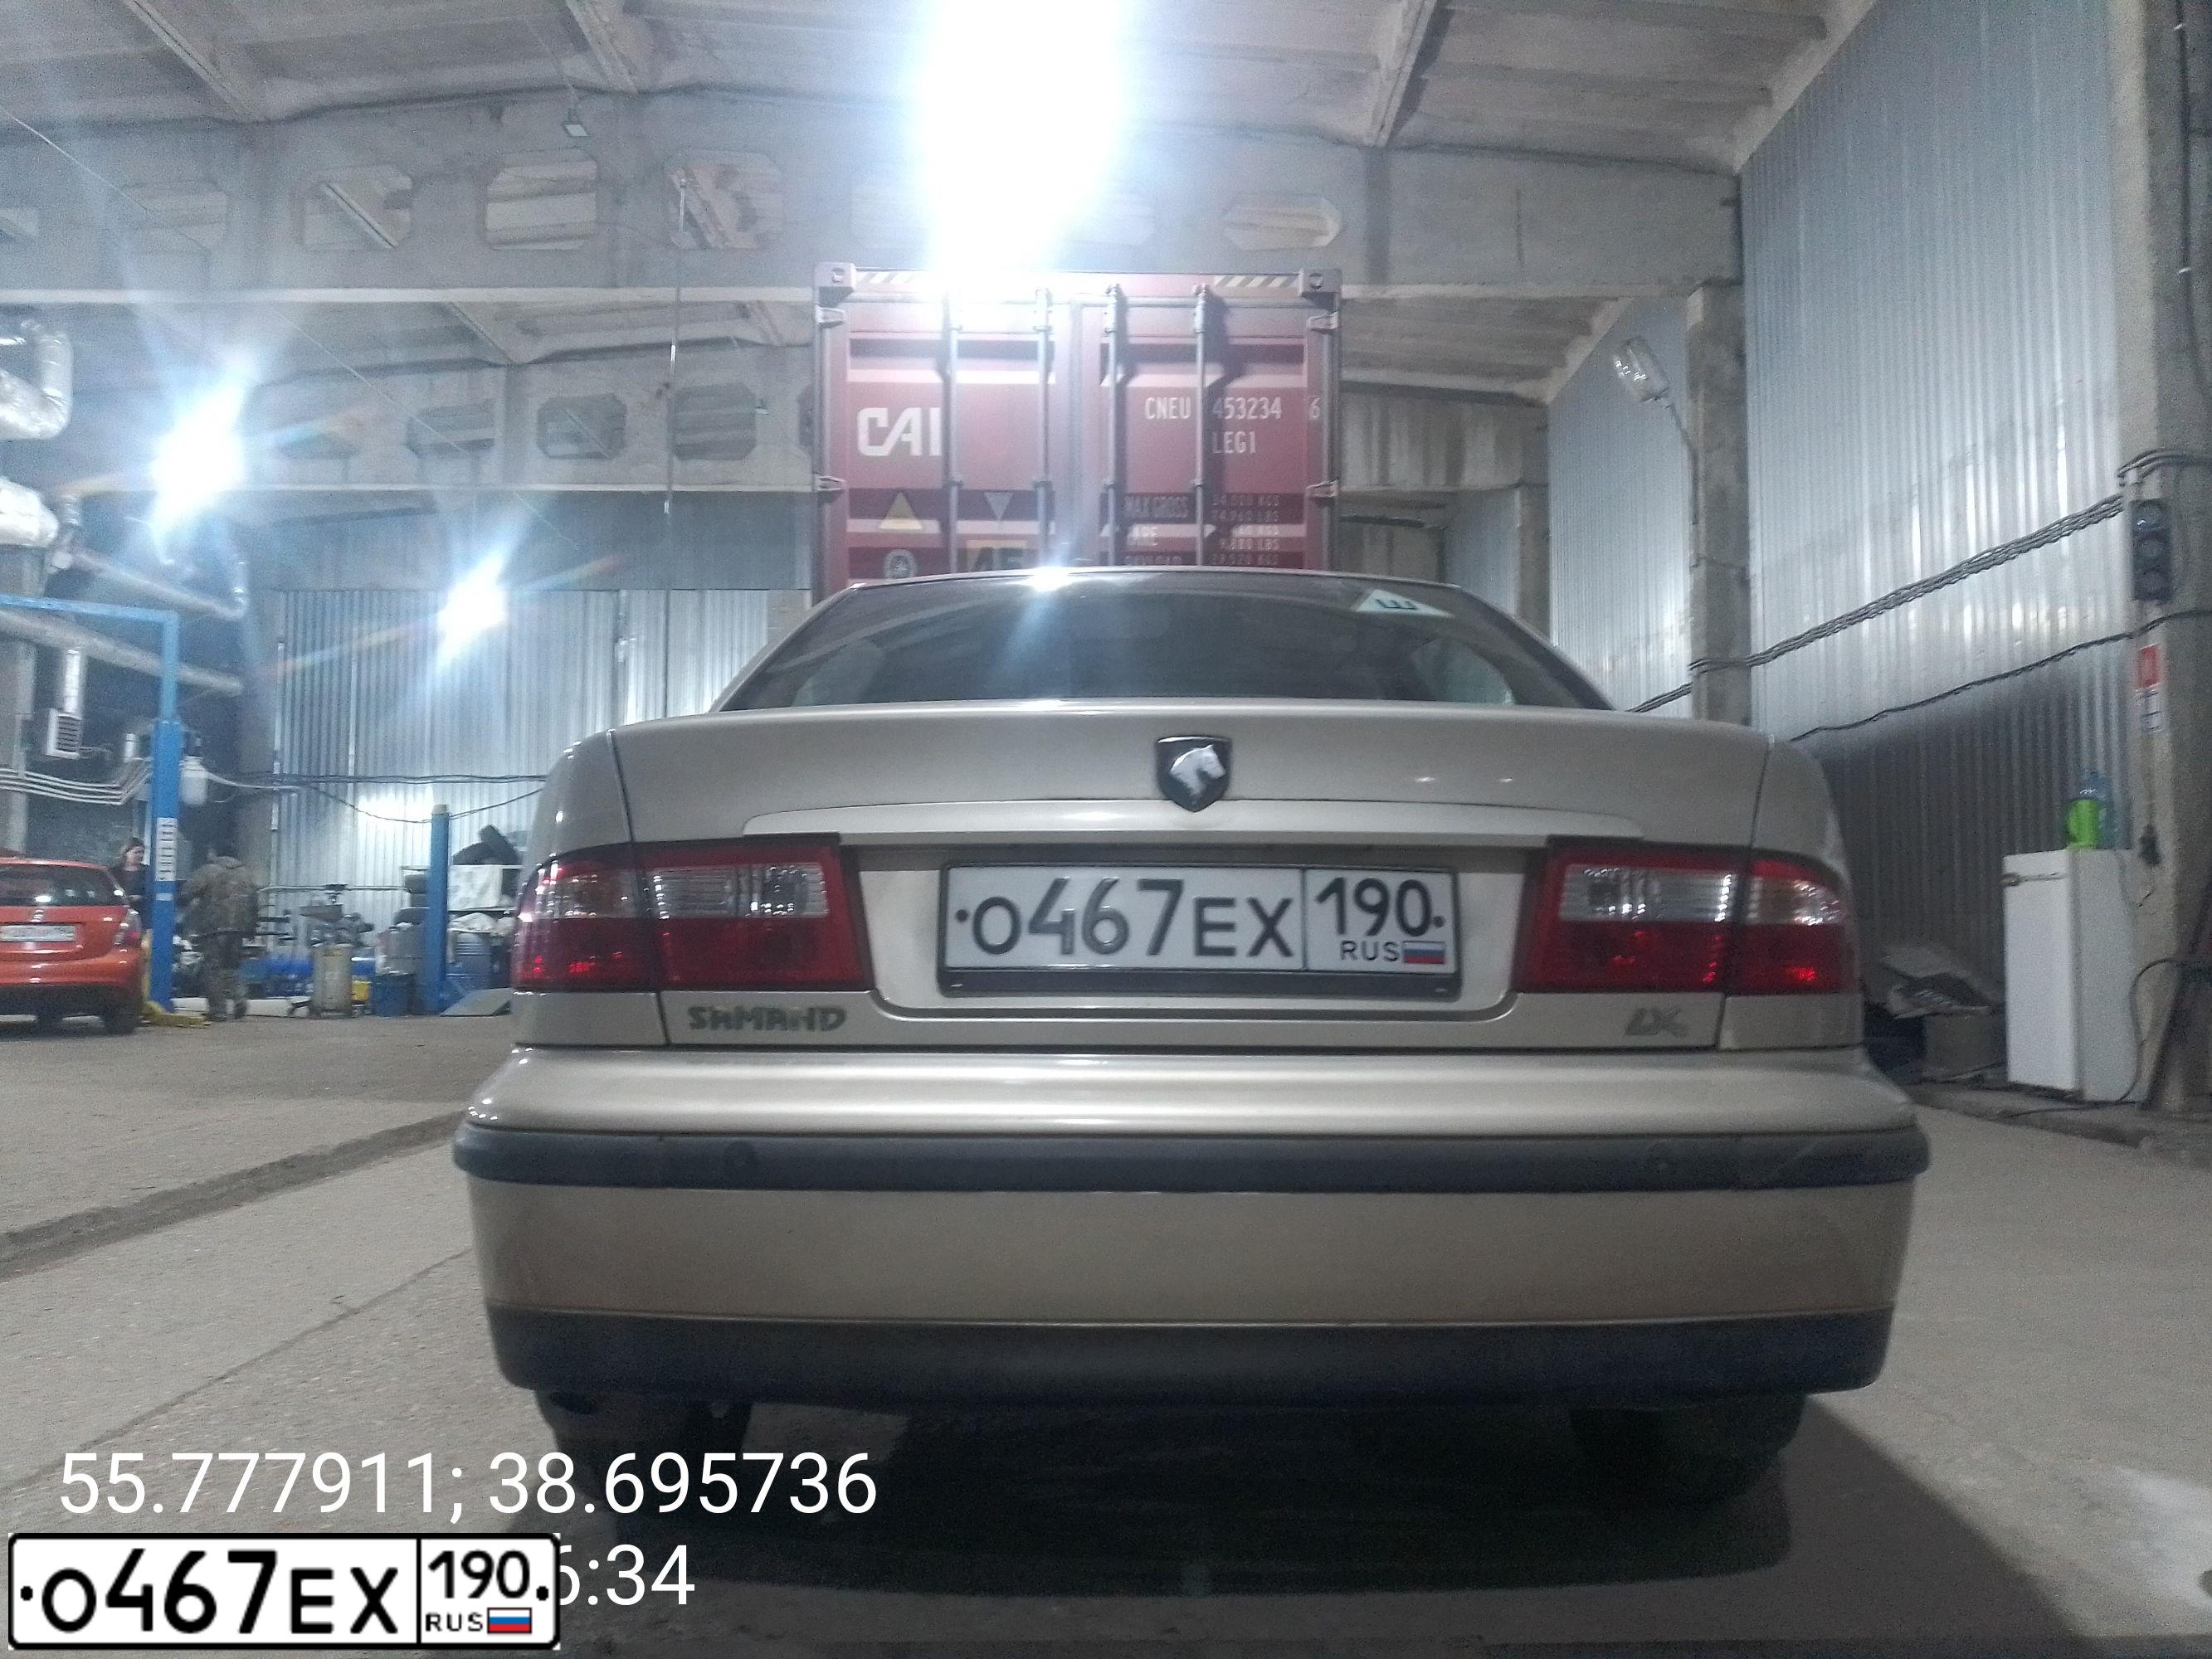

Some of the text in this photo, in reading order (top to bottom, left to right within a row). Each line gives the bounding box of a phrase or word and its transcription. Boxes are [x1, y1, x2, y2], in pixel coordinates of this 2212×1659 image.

[1144, 397, 1191, 420] CNEU
[1211, 397, 1283, 420] 453234
[856, 406, 942, 456] CAI
[1315, 876, 1433, 937] 190
[1341, 940, 1401, 963] RUS
